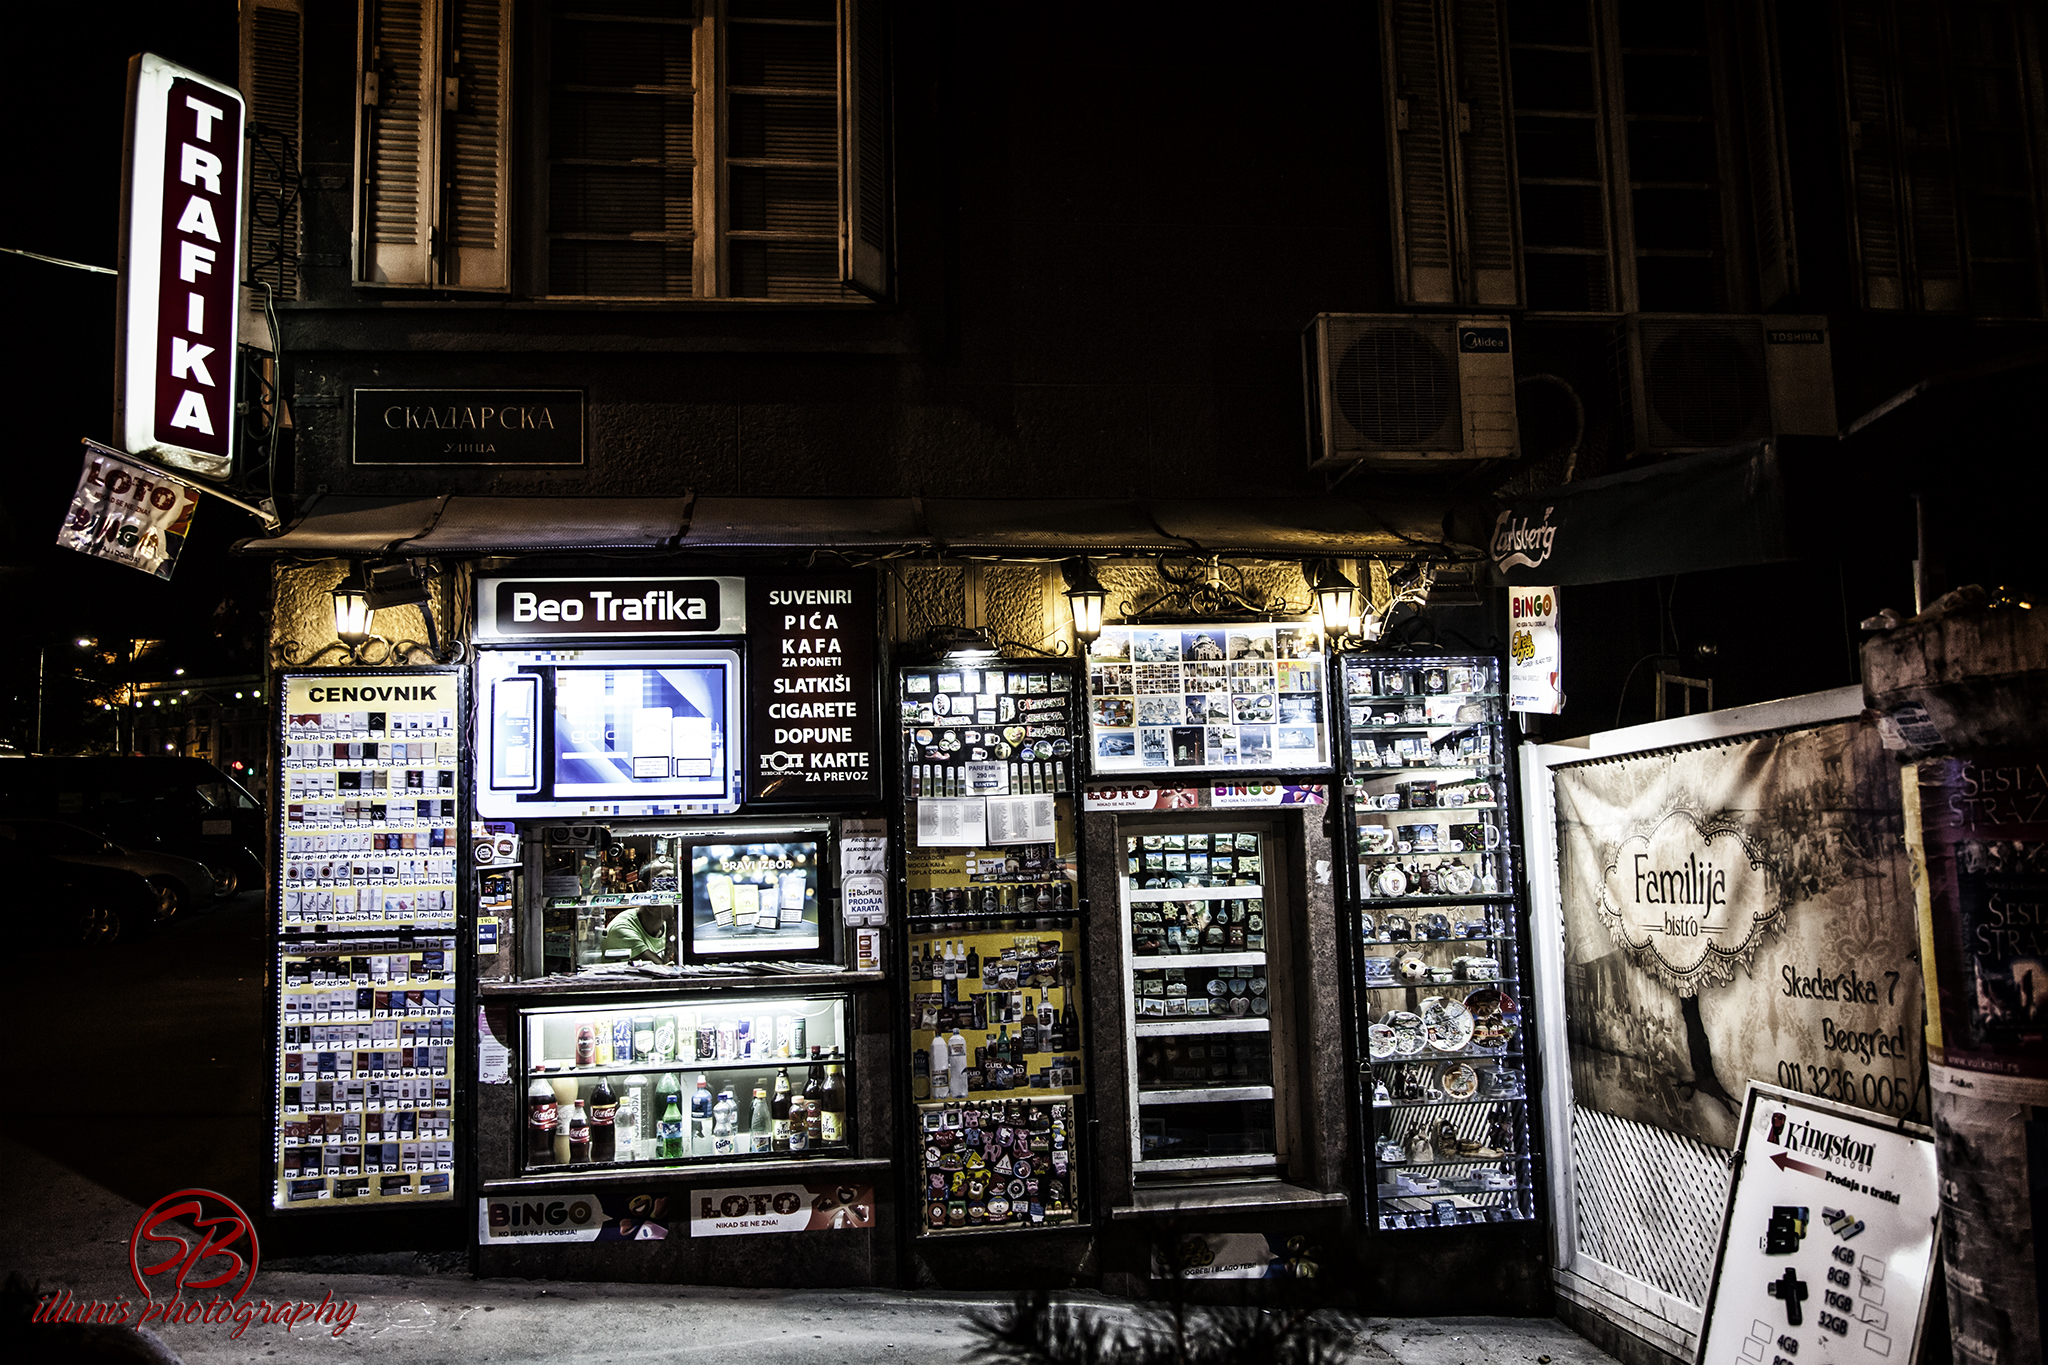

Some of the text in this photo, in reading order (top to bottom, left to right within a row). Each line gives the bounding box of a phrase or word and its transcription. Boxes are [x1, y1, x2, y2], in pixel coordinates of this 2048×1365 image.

[170, 94, 224, 437] TRAFIKA
[1467, 332, 1504, 348] Midea
[1771, 333, 1819, 341] TOSHIBA
[383, 405, 555, 430] СКАДАРСКА
[444, 443, 496, 453] УЛИЦА
[87, 459, 176, 511] LOTO
[1490, 507, 1557, 562] Carlsberg
[513, 591, 707, 622] Beo Trafika
[769, 590, 852, 605] SUVENIRI
[784, 611, 839, 630] PIĆA
[782, 638, 842, 654] KAFA
[782, 656, 841, 667] ZA PONETI
[773, 674, 851, 693] SLATKIŠI
[309, 686, 437, 702] CENOVNIK
[768, 702, 857, 718] CIGARETE
[571, 727, 619, 743] gold
[774, 727, 852, 744] DOPUNE
[810, 753, 869, 768] KARTE
[805, 771, 869, 782] ZA PREVOZ
[722, 859, 793, 871] PRAVI IZBOR
[1633, 852, 1726, 918] Familija
[1988, 893, 2048, 929] ŠEST
[1664, 911, 1698, 937] bistro
[1781, 964, 1900, 1006] Skadarska 7
[1822, 1017, 1907, 1065] Beograd
[1778, 1060, 1909, 1112] 011 3236 005
[1784, 1120, 1875, 1167] Kingston
[1800, 1146, 1872, 1174] TECHNOLOGY
[1825, 1170, 1901, 1205] Prodaja u trafici
[701, 1192, 801, 1218] LOTO
[1831, 1245, 1855, 1265] 4GB
[1216, 1264, 1238, 1272] BLAGO
[1827, 1267, 1850, 1287] 8GB
[1818, 1311, 1848, 1336] 32GB
[1777, 1334, 1799, 1355] 4GB
